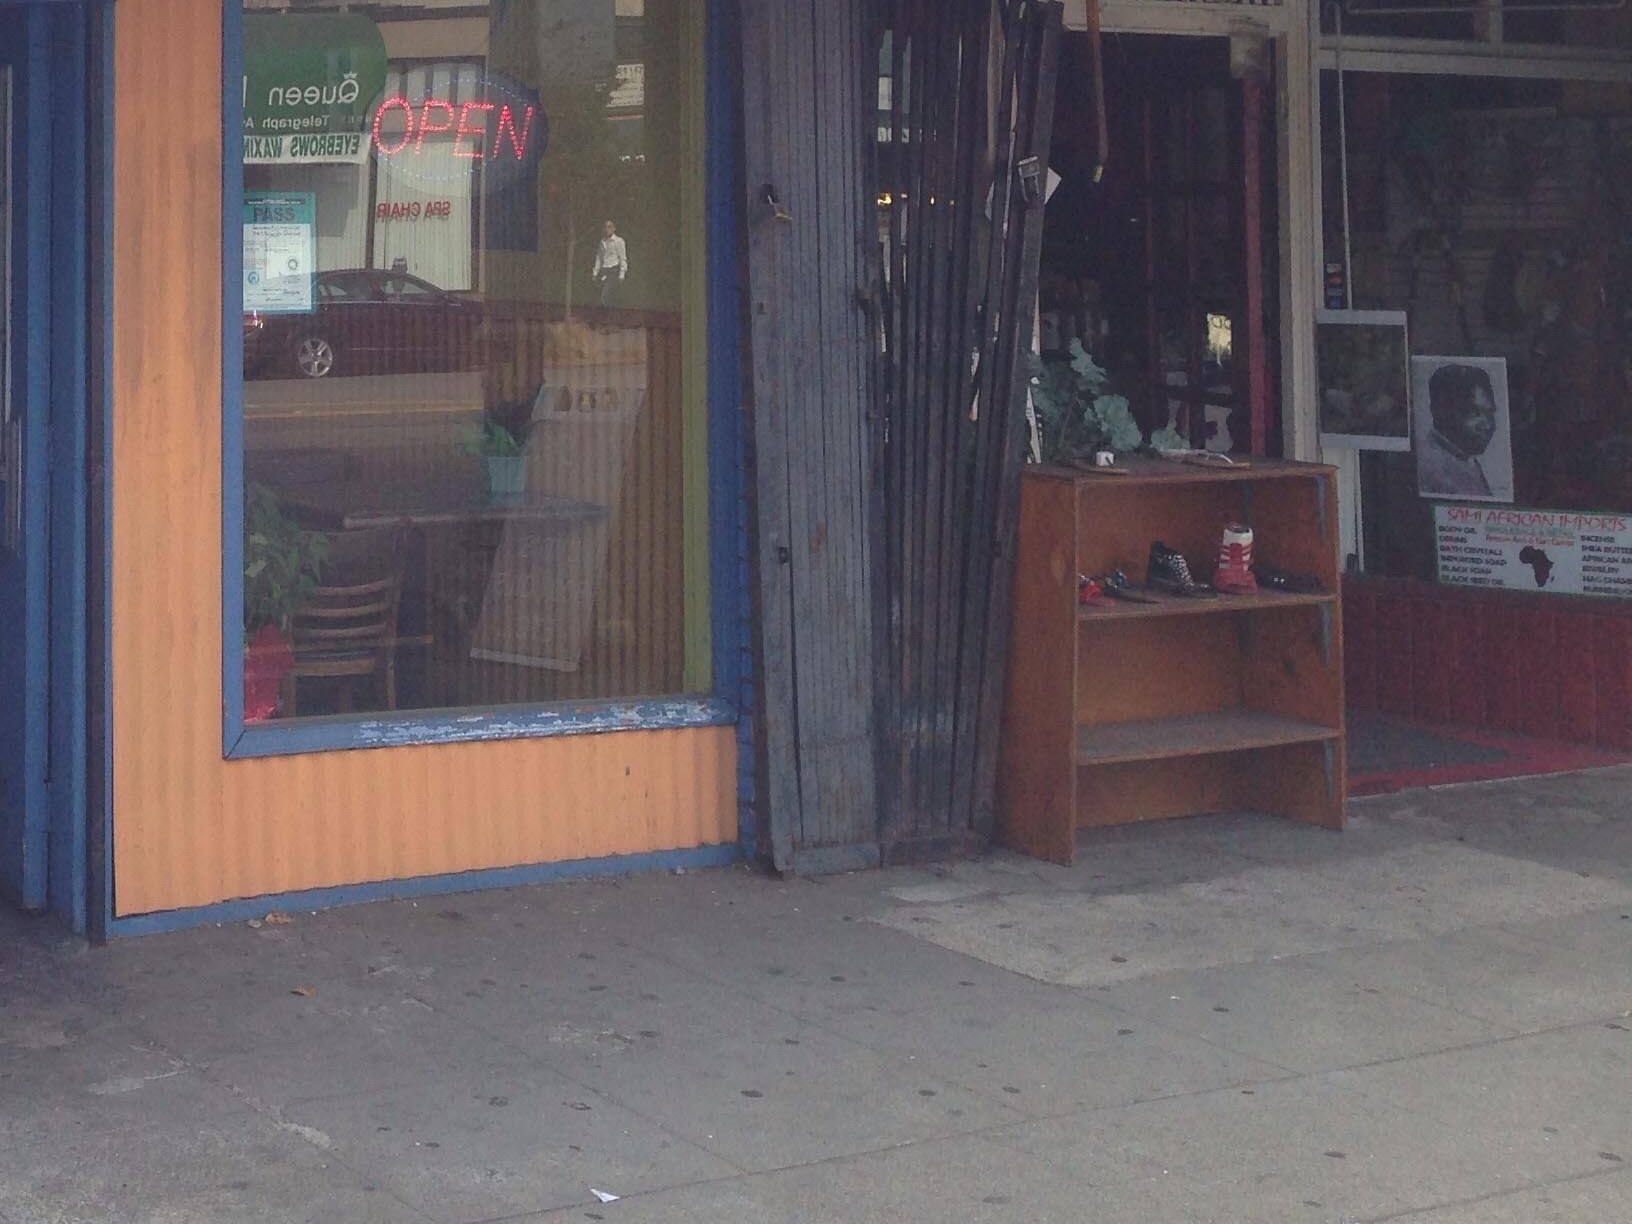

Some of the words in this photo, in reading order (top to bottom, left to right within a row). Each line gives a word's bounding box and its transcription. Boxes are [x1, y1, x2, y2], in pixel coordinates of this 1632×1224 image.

[371, 96, 534, 161] OPEN
[1487, 510, 1554, 526] AFRICAN
[1560, 514, 1628, 531] IMPORTS
